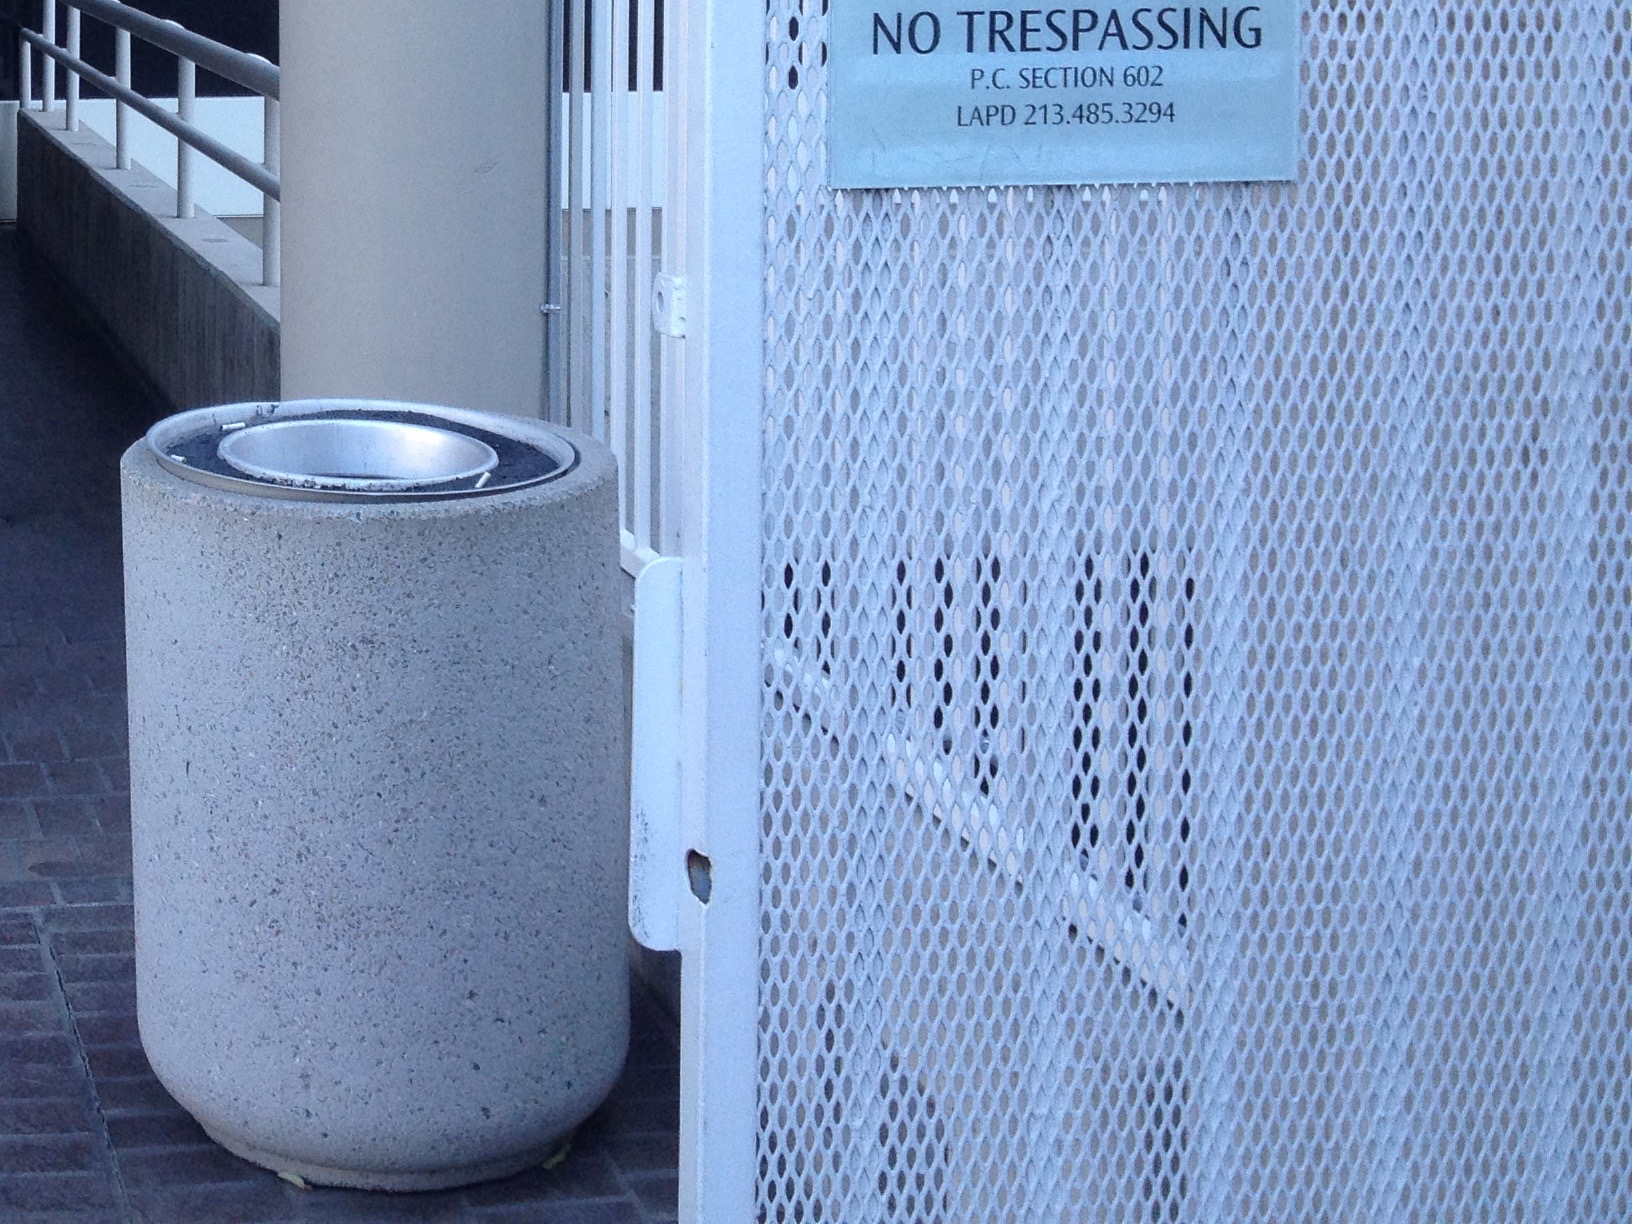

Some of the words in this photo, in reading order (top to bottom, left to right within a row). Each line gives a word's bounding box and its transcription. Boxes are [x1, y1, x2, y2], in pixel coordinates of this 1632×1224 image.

[872, 11, 941, 55] NO
[956, 5, 1262, 53] TRESPASSING
[970, 67, 1011, 90] P.C.
[1018, 66, 1114, 89] SECTION
[1123, 65, 1164, 88] 602
[957, 104, 1017, 127] LAPD
[1024, 101, 1176, 126] 213.485.3294
